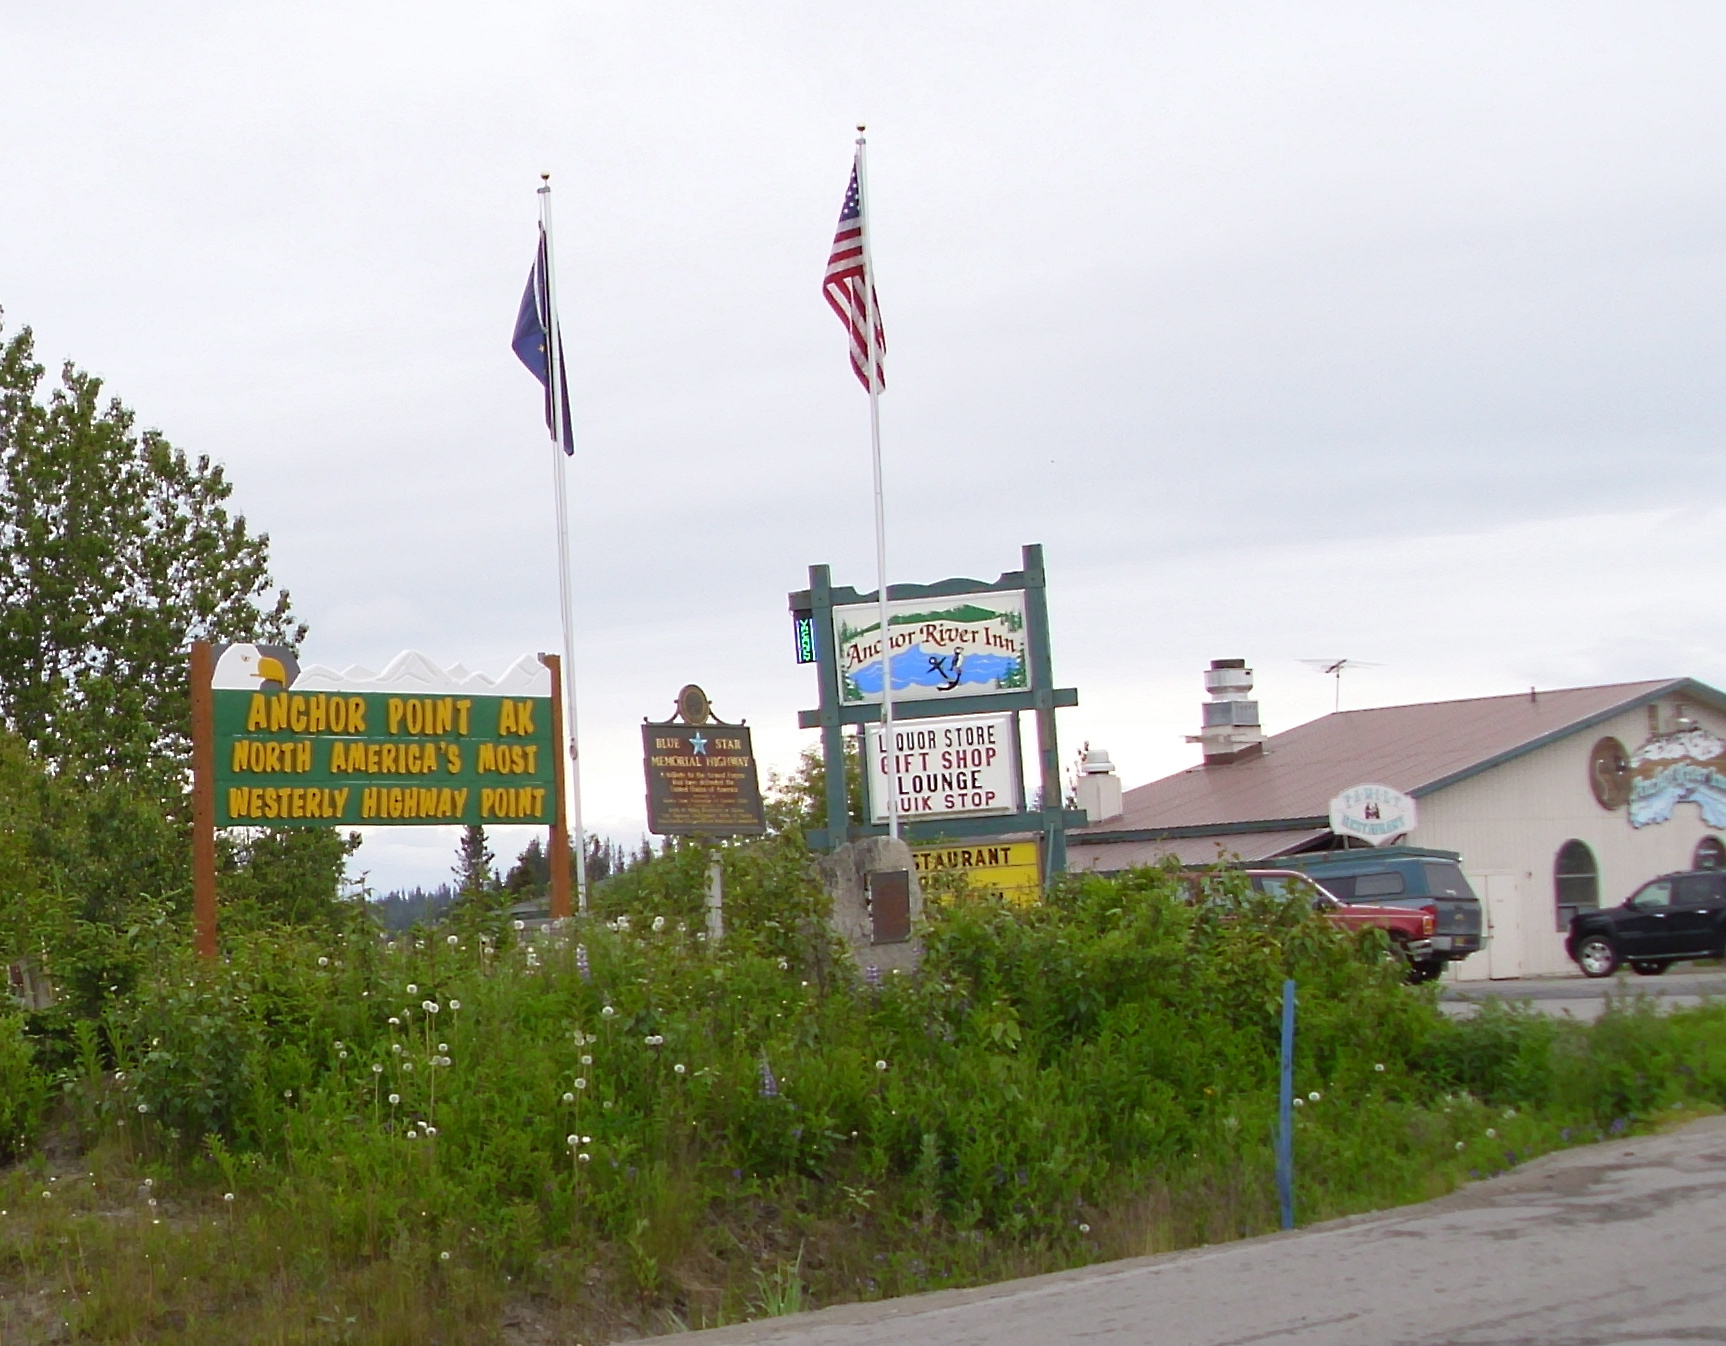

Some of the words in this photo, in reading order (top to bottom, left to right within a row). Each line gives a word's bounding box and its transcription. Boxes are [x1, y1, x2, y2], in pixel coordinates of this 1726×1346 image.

[920, 622, 979, 647] River
[984, 626, 1017, 653] Inn
[247, 692, 367, 733] ANCHOR
[387, 697, 472, 736] POINT
[498, 698, 536, 737] AK
[656, 737, 681, 749] BLUE
[715, 738, 742, 749] STAR
[878, 730, 937, 753] LQUOR
[944, 725, 996, 748] STORE
[231, 738, 312, 773] NORTH
[330, 740, 462, 775] AMERICA'S
[478, 742, 538, 775] MOST
[651, 755, 702, 767] MEMORIAL
[706, 756, 749, 767] HIGHWAY
[941, 747, 997, 770] SHOP
[897, 769, 983, 795] LOUNGE
[227, 785, 350, 819] WESTERLY
[361, 786, 469, 819] HIGHWAY
[480, 787, 547, 819] POINT
[944, 791, 996, 809] STOP
[912, 847, 1011, 871] STAURANT
